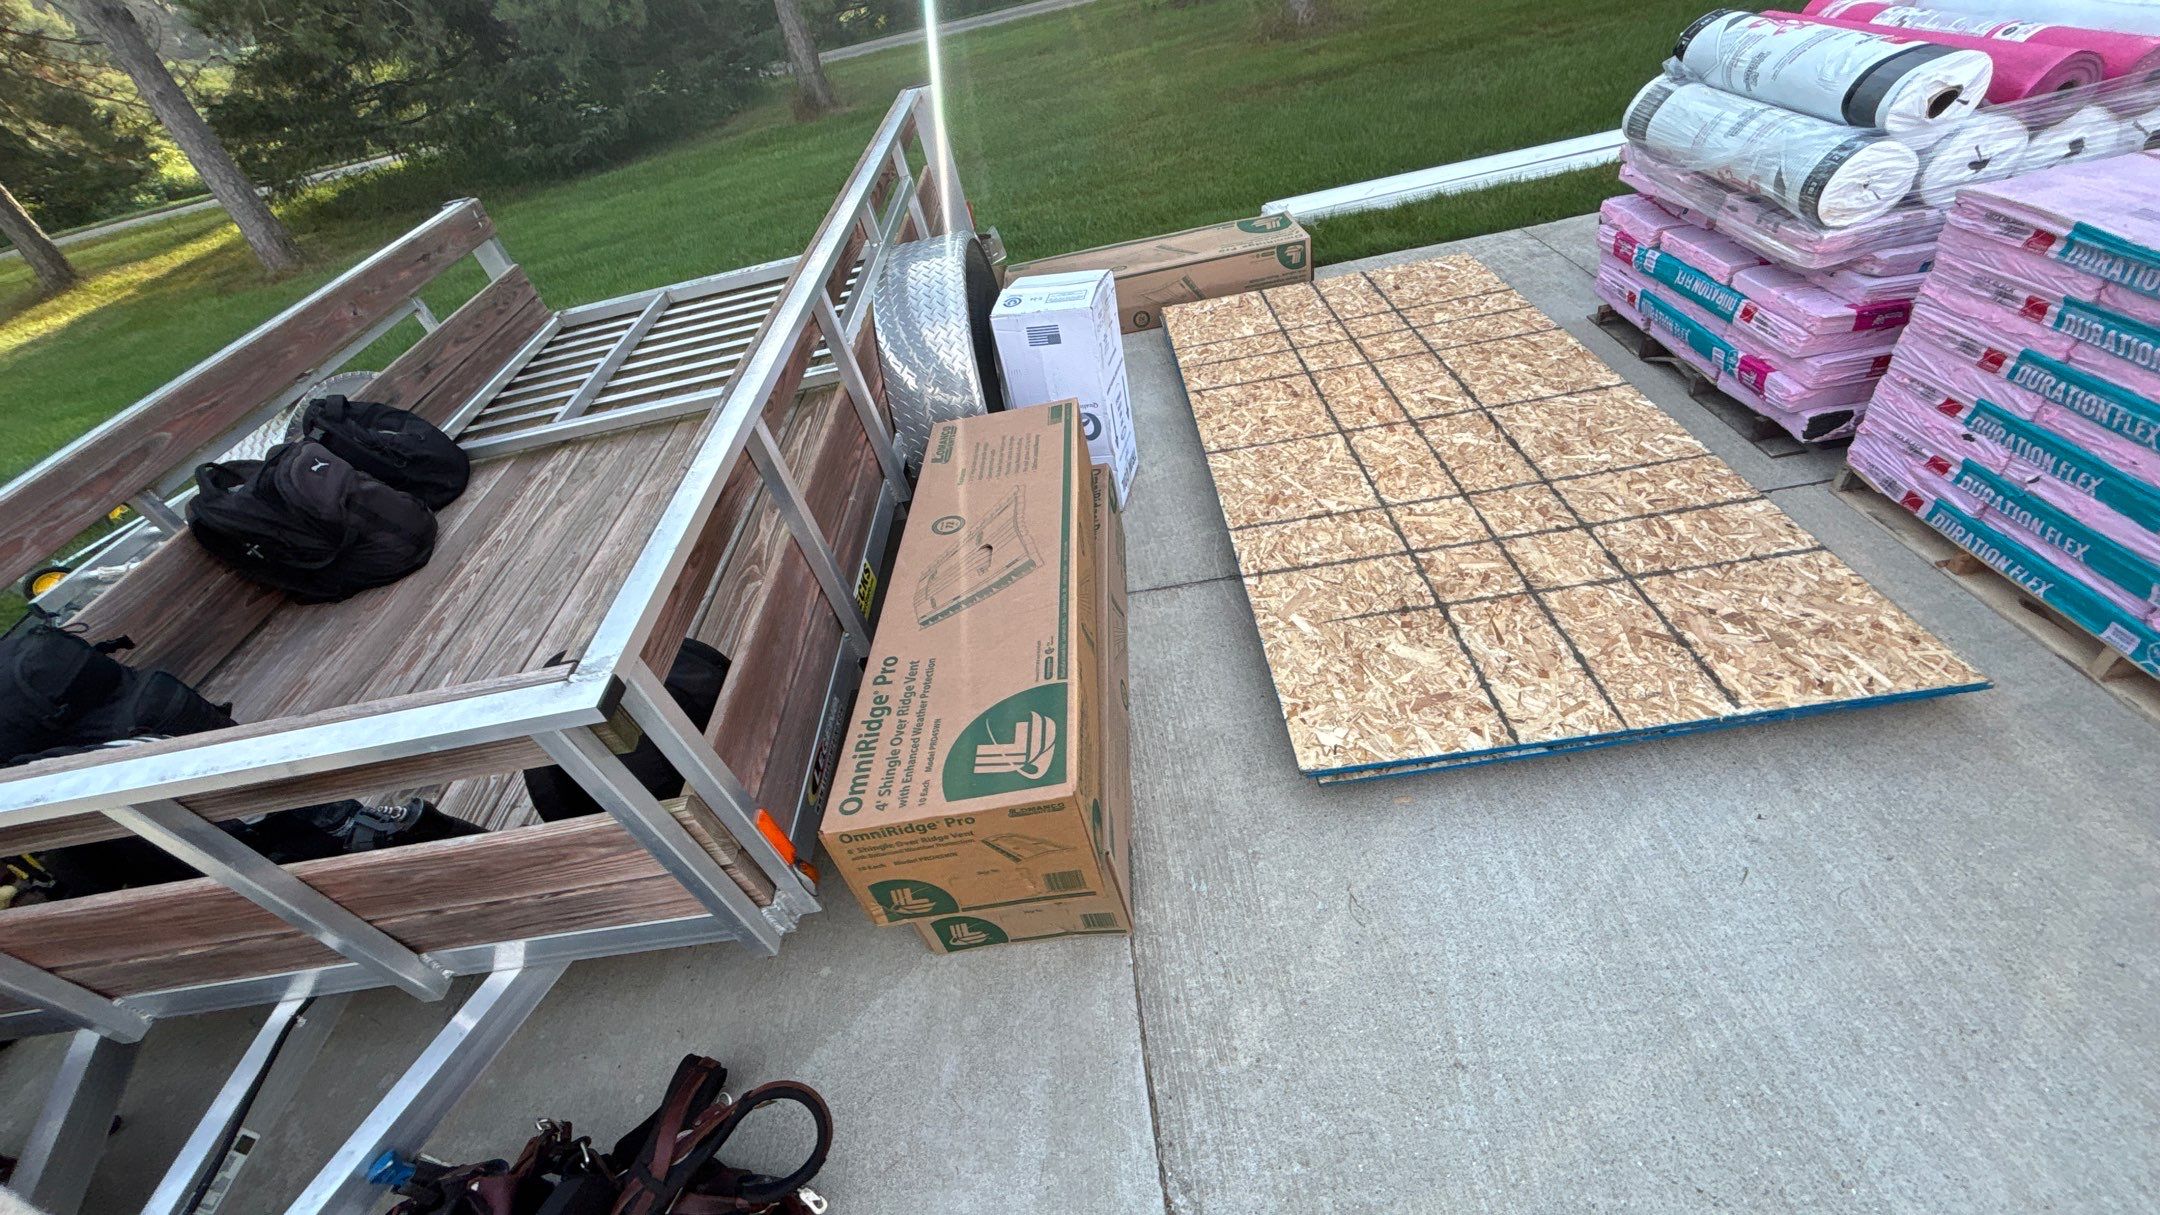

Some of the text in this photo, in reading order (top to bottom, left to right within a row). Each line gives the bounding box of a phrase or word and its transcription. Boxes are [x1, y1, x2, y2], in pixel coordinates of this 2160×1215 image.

[2066, 244, 2160, 293] DURATIO
[1692, 276, 1738, 312] DURATION
[2014, 364, 2159, 451] DURATION FLEX
[1969, 416, 2057, 474] DURATION
[2056, 460, 2105, 497] FLEX
[1956, 475, 2045, 537] DURATION
[2045, 526, 2091, 563] FLEX
[1930, 512, 2055, 600] DURATION FLEX
[904, 659, 921, 686] Vent
[897, 687, 917, 718] Ridge
[838, 655, 898, 816] OmniRidge Pro
[890, 718, 907, 747] Over
[898, 657, 936, 809] with Enhanced Weather Protection
[878, 744, 901, 797] Shingle
[925, 747, 936, 773] Model
[918, 797, 927, 807] 10
[920, 779, 931, 798] Each
[920, 833, 949, 845] Ridge
[949, 830, 974, 840] Vent
[944, 816, 976, 828] Pro
